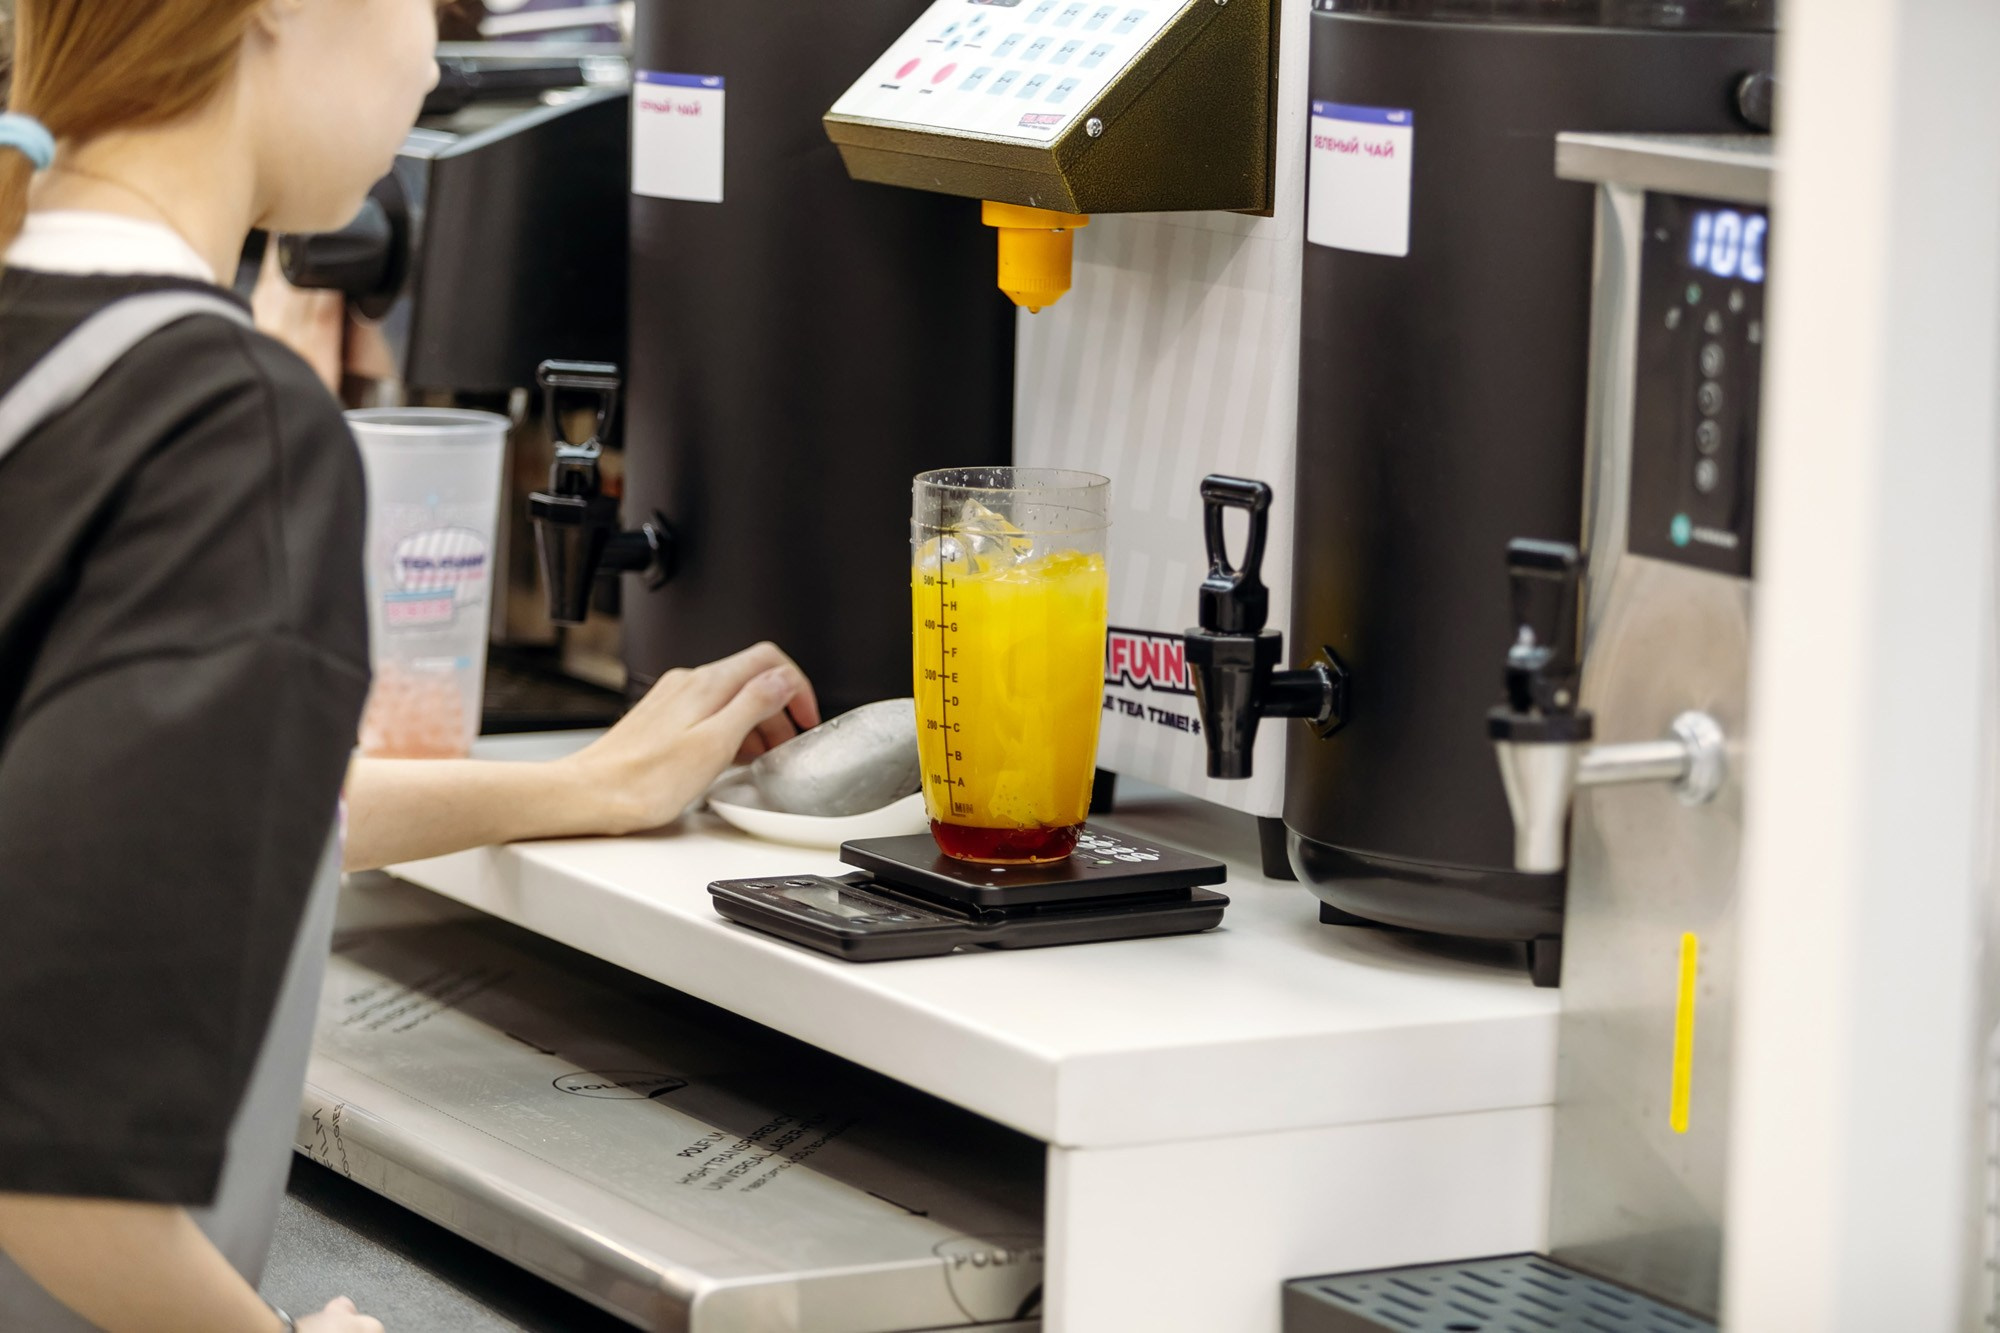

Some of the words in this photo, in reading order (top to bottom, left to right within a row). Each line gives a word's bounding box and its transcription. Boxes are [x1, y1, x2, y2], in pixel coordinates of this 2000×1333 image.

[1364, 141, 1394, 158] ЧАЙ
[924, 575, 934, 586] 500
[950, 601, 957, 611] H
[925, 619, 935, 630] 400
[951, 622, 958, 632] G
[951, 647, 958, 657] F
[925, 668, 936, 681] 300
[952, 672, 958, 683] E
[952, 696, 959, 707] D
[1117, 699, 1144, 719] TEA
[1147, 706, 1189, 732] TIME!
[927, 719, 937, 730] 200
[953, 722, 960, 732] C
[955, 750, 962, 761] B
[931, 774, 941, 785] 100
[957, 777, 965, 787] A
[332, 1102, 351, 1179] OLOGIES
